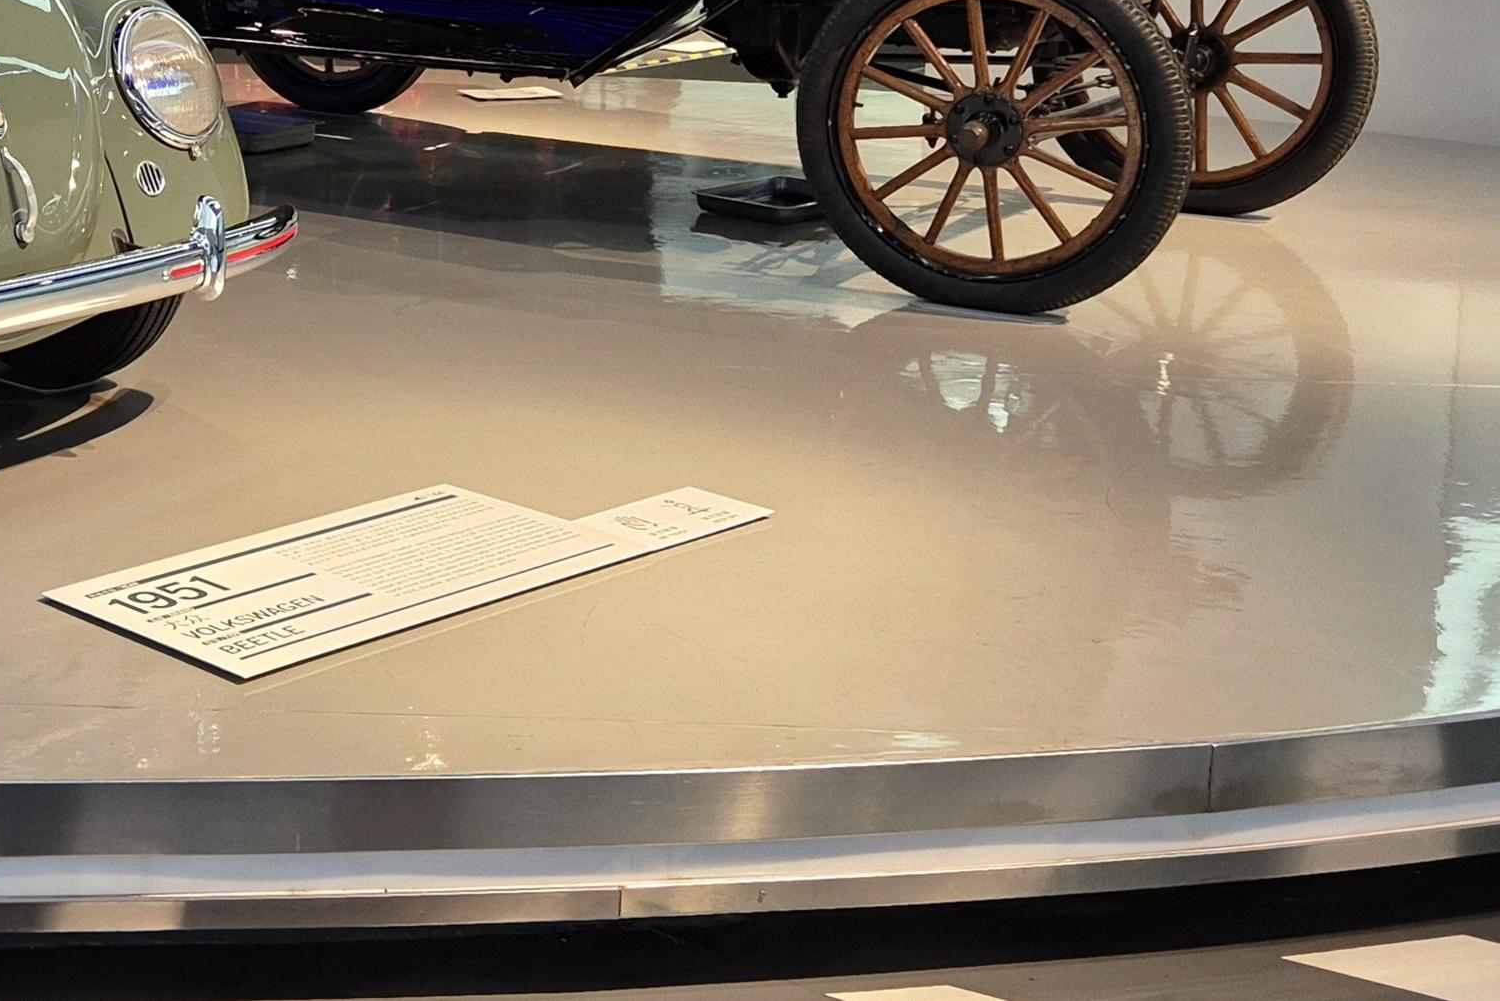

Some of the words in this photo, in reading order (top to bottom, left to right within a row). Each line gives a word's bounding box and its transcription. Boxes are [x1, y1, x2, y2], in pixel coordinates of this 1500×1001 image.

[108, 575, 230, 614] 1951
[164, 613, 210, 630] 大众
[182, 594, 326, 639] VOLKSWAGEN
[219, 625, 306, 655] BEETLE
